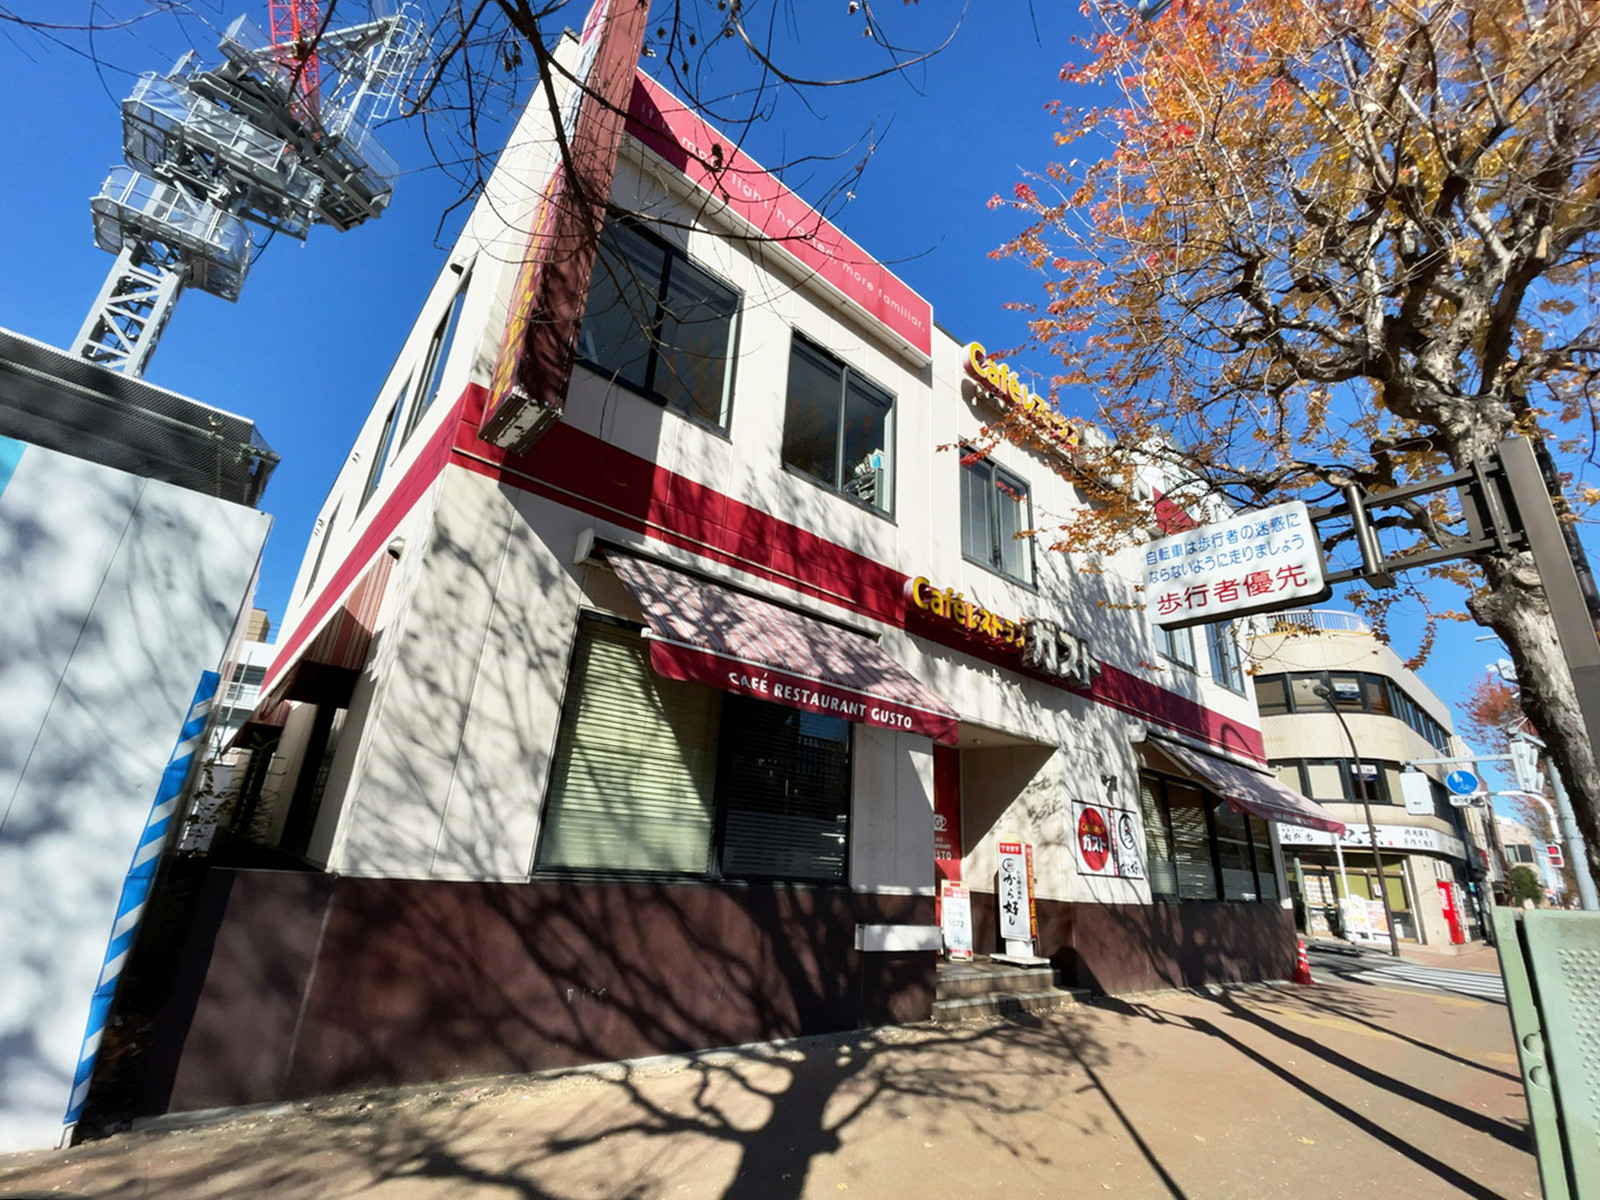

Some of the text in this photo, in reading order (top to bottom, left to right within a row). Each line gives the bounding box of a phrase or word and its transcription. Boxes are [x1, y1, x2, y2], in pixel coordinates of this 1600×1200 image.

[681, 136, 724, 173] mor
[842, 262, 874, 290] more
[878, 288, 926, 332] familiar.
[1145, 512, 1301, 566] 自転車は歩行者の迷惑に
[1148, 533, 1305, 584] ならないように走りましょう
[1157, 564, 1308, 616] 歩行者優先
[728, 672, 913, 729] CAFÉ RESTAURANT GUSTO
[934, 850, 952, 861] STO
[1082, 834, 1107, 853] ガスト
[1003, 873, 1020, 926] から好し
